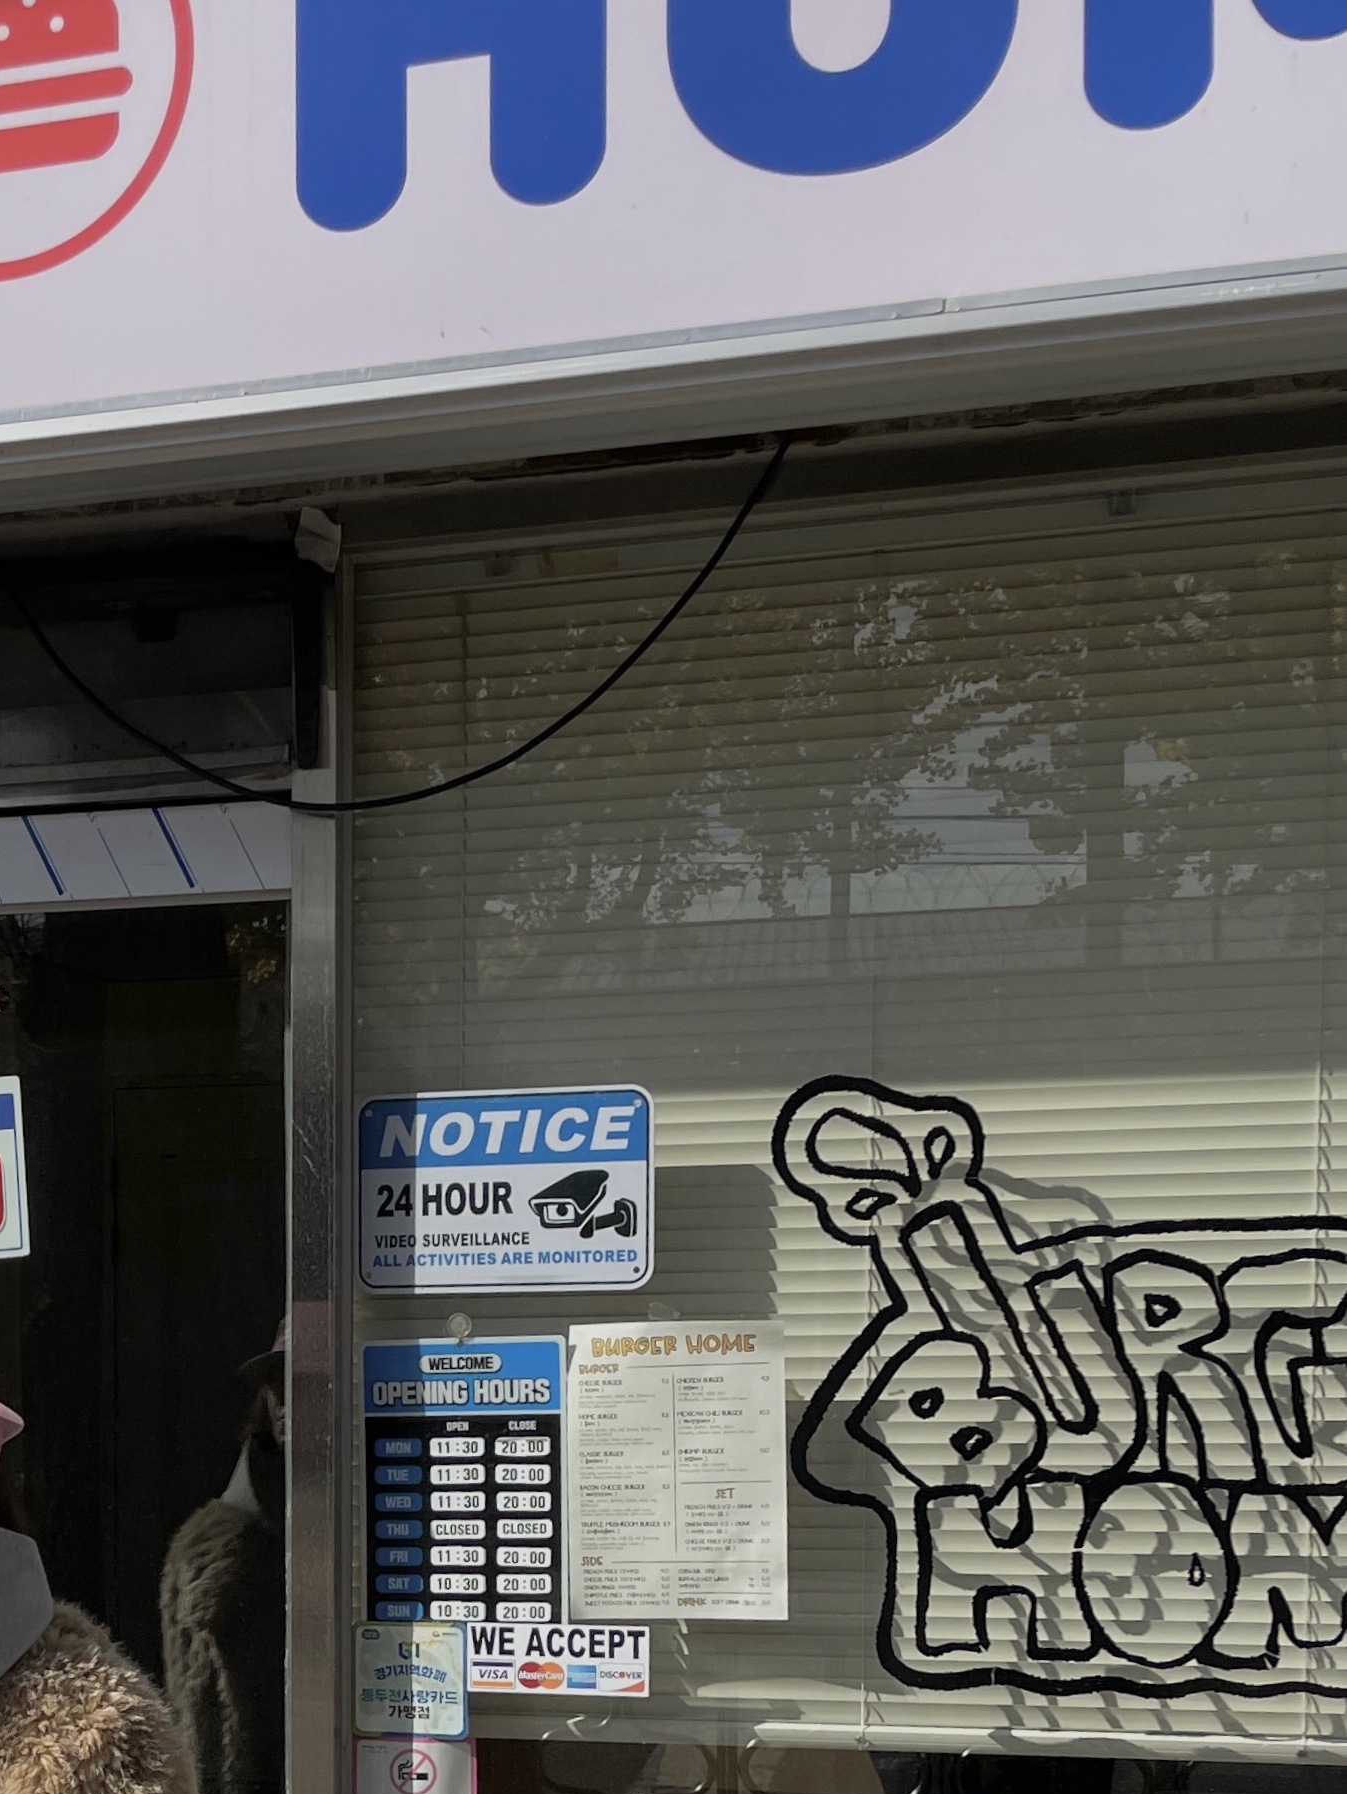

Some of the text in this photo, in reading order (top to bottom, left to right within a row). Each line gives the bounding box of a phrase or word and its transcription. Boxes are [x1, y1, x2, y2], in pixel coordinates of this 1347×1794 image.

[378, 1105, 636, 1158] NOTICE
[376, 1182, 513, 1218] 24 HOUR
[375, 1231, 530, 1249] VIDEO SURVEILLANCE
[372, 1249, 638, 1268] ALL ACTIVITIES ARE MONITORED
[591, 1334, 756, 1357] BURGER HOME
[428, 1356, 494, 1371] WELCOME
[372, 1380, 468, 1405] OPENING
[474, 1378, 550, 1404] HOURS
[446, 1420, 536, 1431] OPEN CLOSE
[385, 1441, 411, 1454] MON
[386, 1469, 409, 1481] TUE
[715, 1487, 735, 1499] SET
[385, 1496, 411, 1508] WED
[386, 1523, 547, 1536] THU CLOSED CLOSED
[389, 1551, 409, 1563] FRI
[580, 1556, 603, 1567] SIDE
[388, 1578, 410, 1590] SAT
[386, 1604, 411, 1617] SUN
[471, 1626, 646, 1660] WE ACCEPT
[479, 1668, 509, 1679] VISA
[388, 1705, 430, 1719] 가맹점
